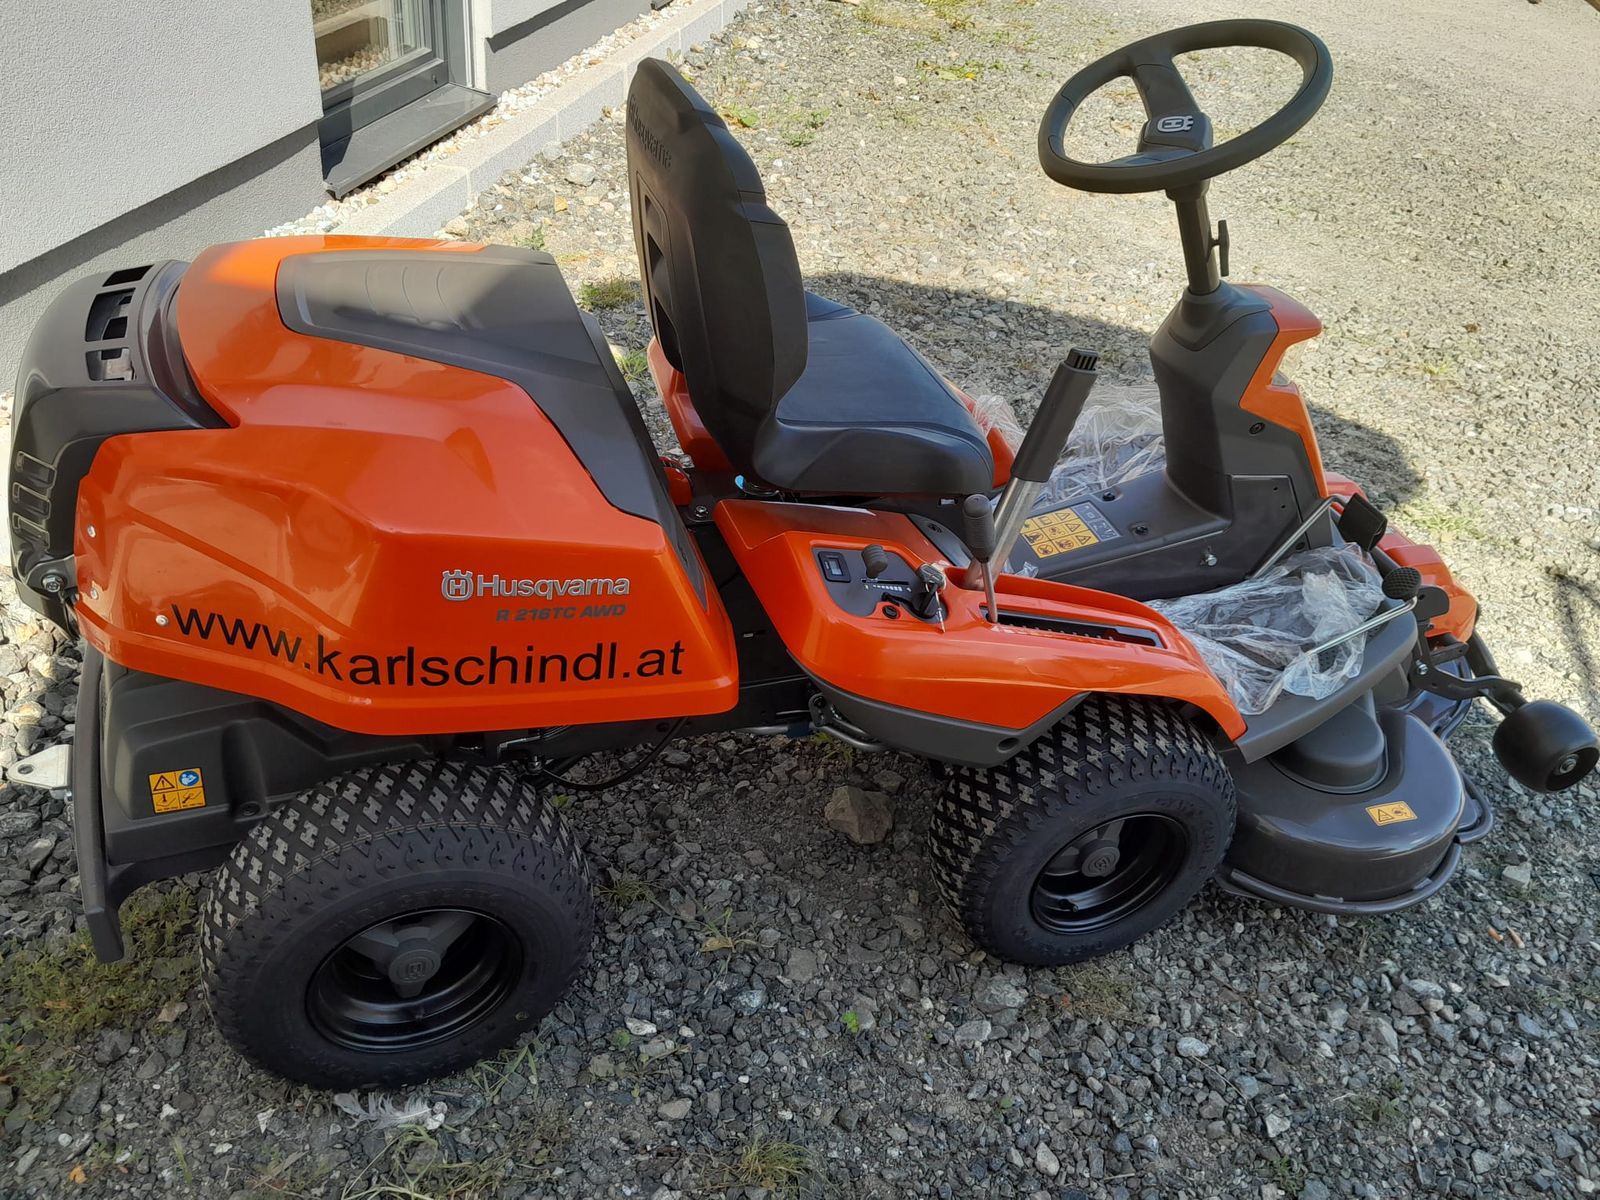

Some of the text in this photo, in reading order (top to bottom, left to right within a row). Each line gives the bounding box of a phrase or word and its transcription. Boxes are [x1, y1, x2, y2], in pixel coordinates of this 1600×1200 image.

[477, 574, 631, 600] Husqvarna
[496, 609, 510, 622] R
[580, 603, 627, 619] AWD
[171, 603, 686, 687] www.karlschindl.at
